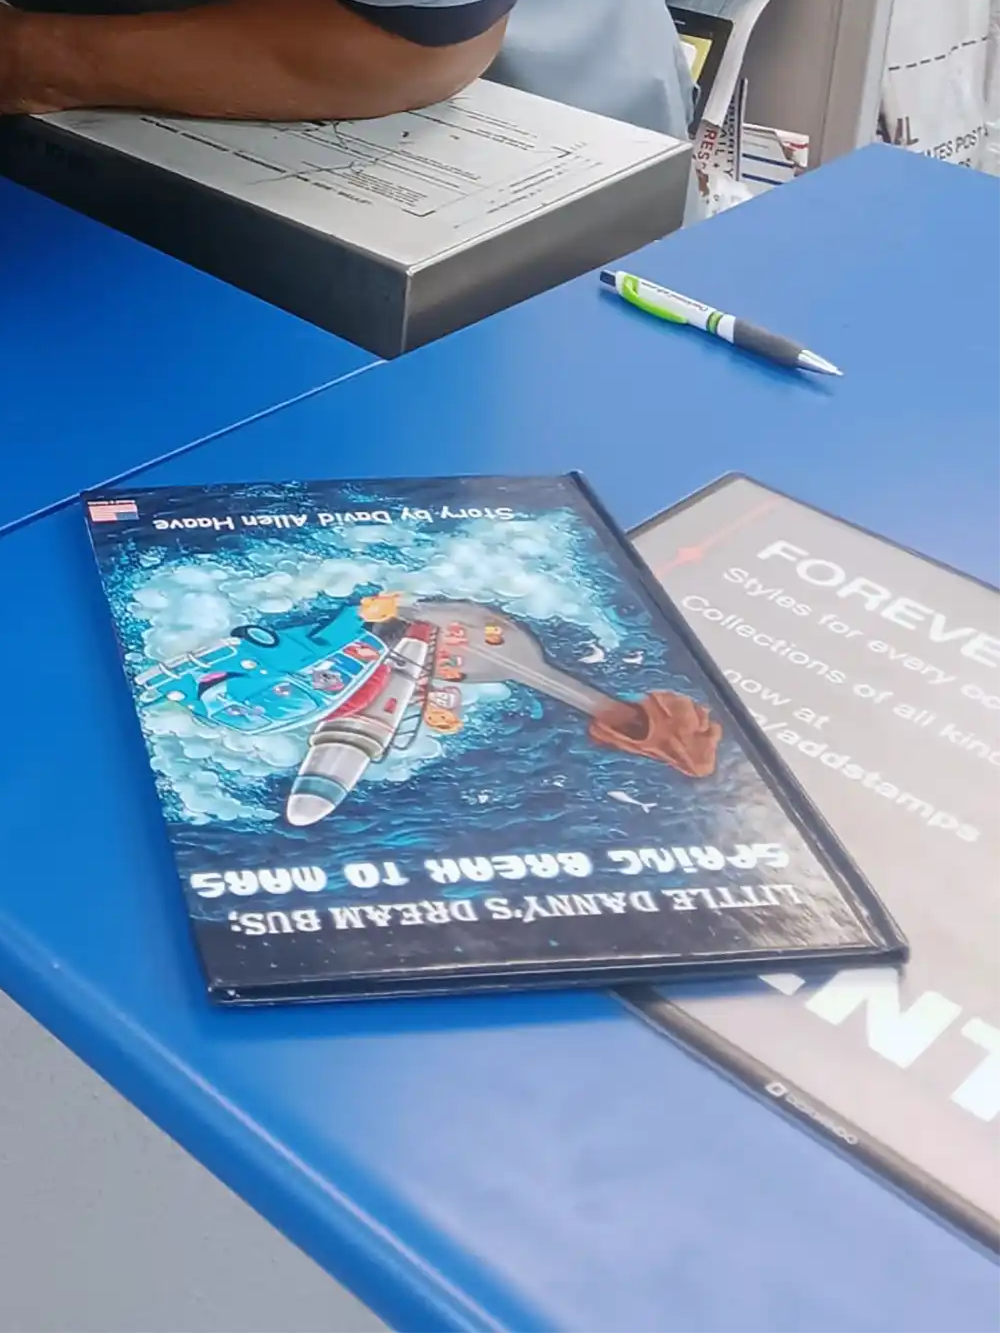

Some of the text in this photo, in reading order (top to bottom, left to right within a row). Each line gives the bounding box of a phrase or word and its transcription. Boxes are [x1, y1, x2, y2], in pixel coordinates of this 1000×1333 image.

[152, 505, 516, 532] Story by David Allen Haave
[722, 566, 813, 617] Styles
[817, 612, 865, 639] for
[867, 638, 958, 686] every
[680, 593, 848, 686] Collections
[852, 682, 896, 706] of
[892, 701, 937, 729] all
[792, 706, 832, 732] at
[189, 864, 328, 899] MARS
[343, 860, 411, 890] TO
[423, 851, 593, 885] BREAK
[660, 883, 804, 912] LITTLE
[327, 898, 479, 930] DREAM
